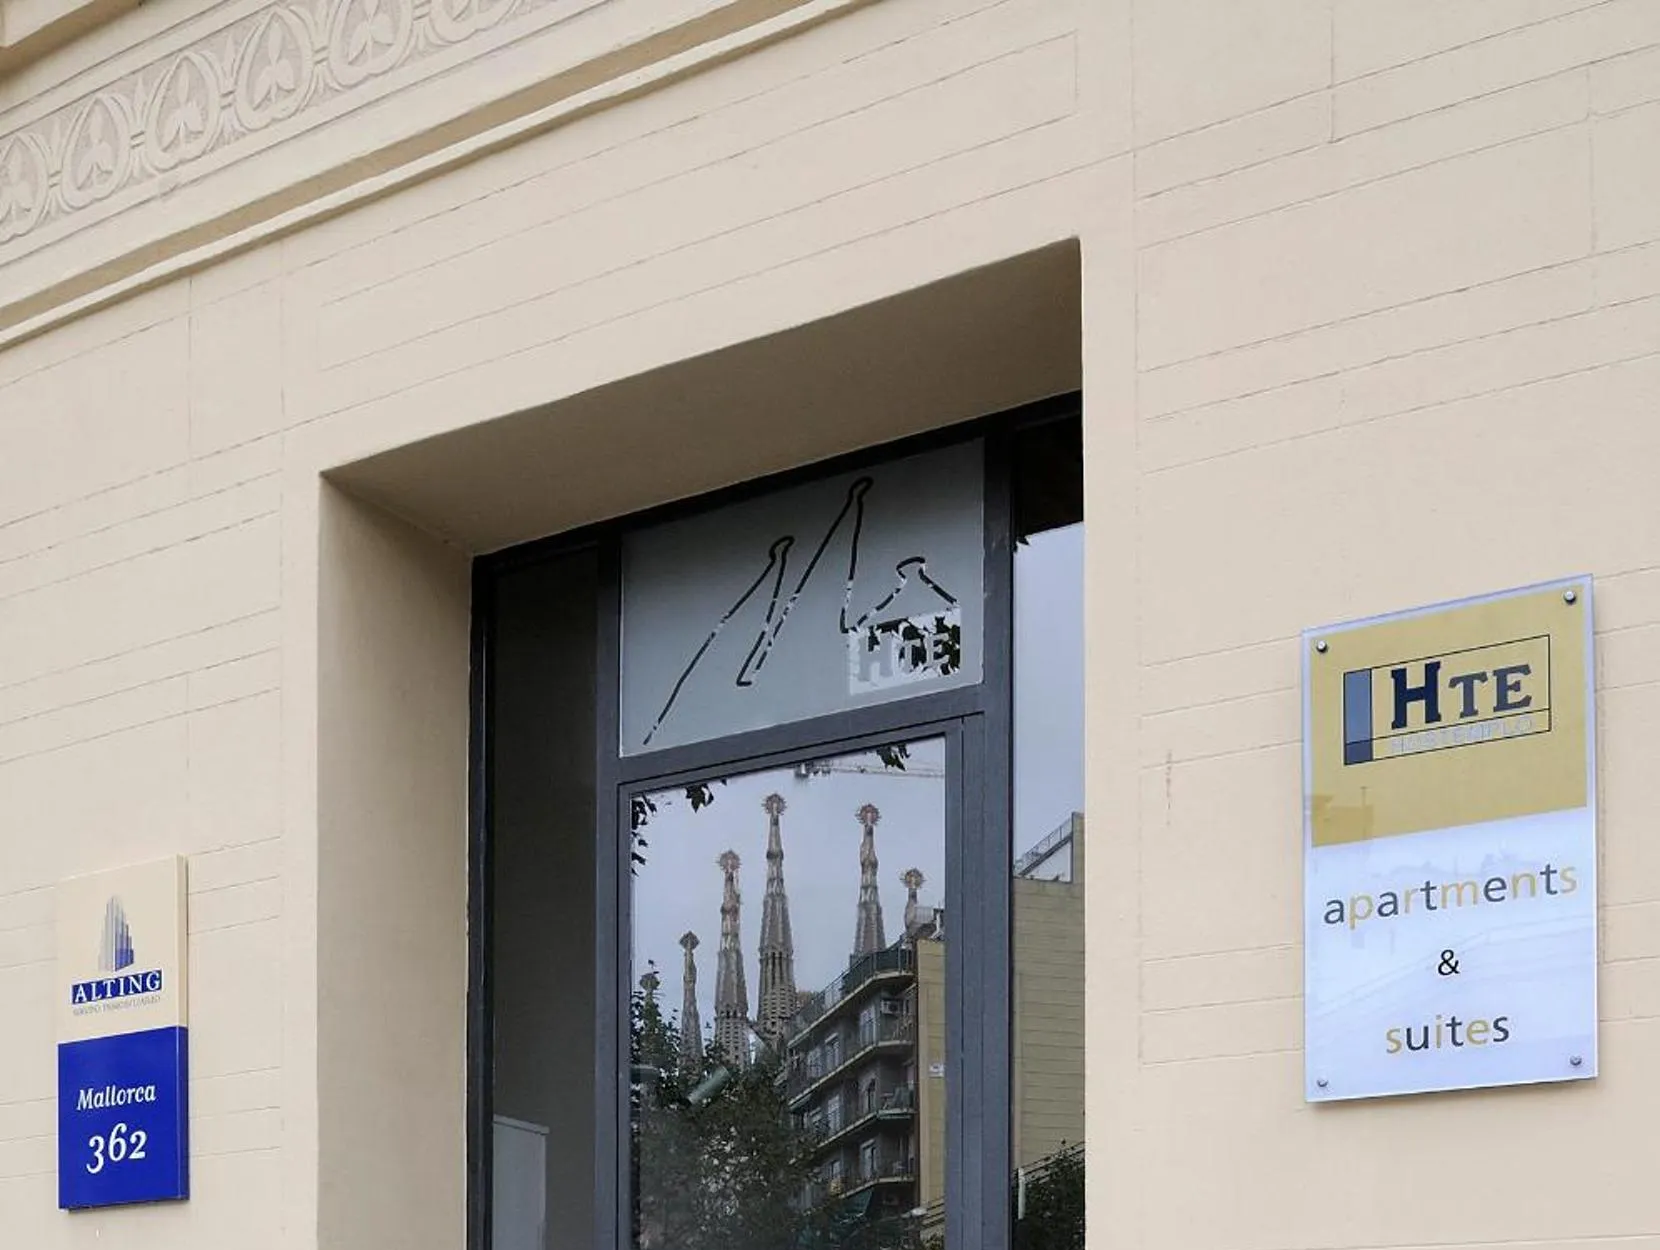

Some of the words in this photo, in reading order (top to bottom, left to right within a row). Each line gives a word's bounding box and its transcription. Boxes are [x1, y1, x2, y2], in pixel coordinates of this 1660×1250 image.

[1391, 661, 1532, 731] HTE
[1324, 864, 1577, 930] apartments
[1437, 949, 1460, 976] &
[74, 972, 161, 1003] ALTING
[1386, 1015, 1509, 1054] suites
[76, 1084, 156, 1111] Mallorca
[86, 1122, 147, 1174] 362
